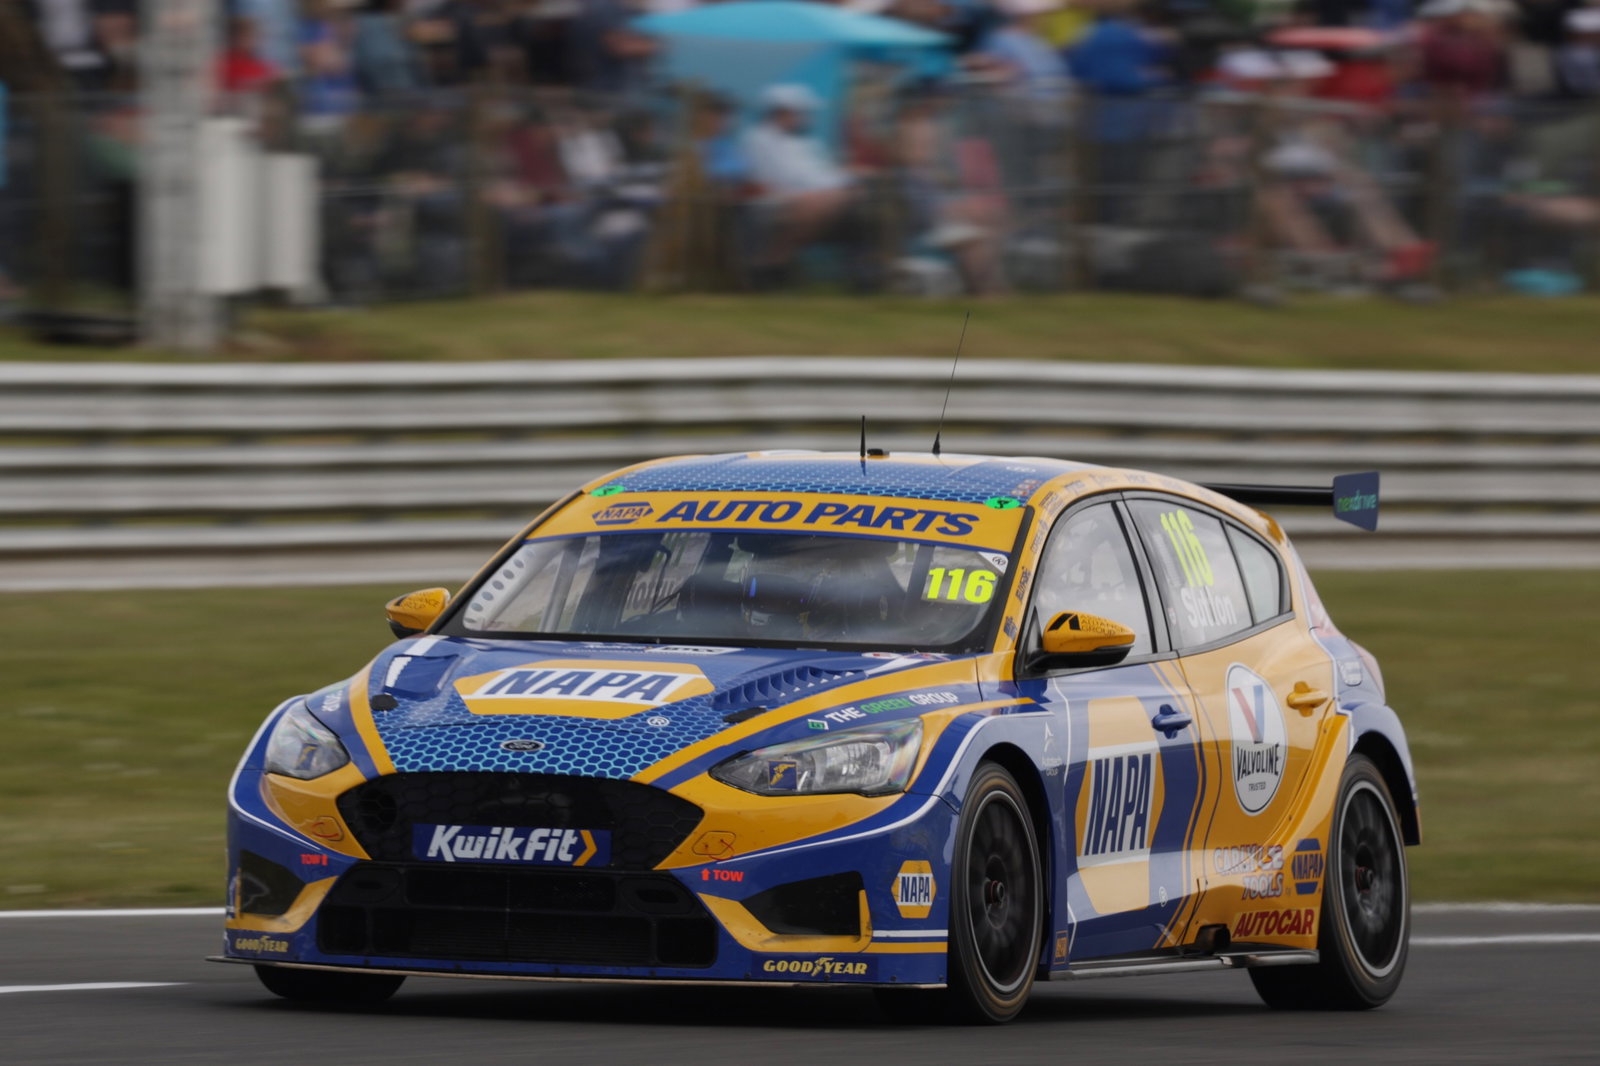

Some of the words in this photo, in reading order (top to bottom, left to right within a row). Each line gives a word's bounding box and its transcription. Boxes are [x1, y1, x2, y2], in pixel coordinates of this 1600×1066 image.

[599, 507, 643, 519] NAPA
[656, 500, 803, 522] AUTO
[803, 502, 980, 536] PARTS
[1160, 509, 1214, 587] 116
[927, 568, 997, 604] 116
[485, 669, 680, 702] NAPA
[825, 707, 866, 723] THE
[860, 697, 916, 714] GREEN
[908, 692, 959, 706] GROUP
[1236, 742, 1280, 782] VALVOLINE
[1248, 781, 1266, 791] TRUSTED
[1084, 753, 1152, 856] NAPA
[300, 854, 320, 865] TOW
[1294, 853, 1320, 880] NAPA
[713, 869, 744, 882] TOW
[898, 875, 931, 903] NAPA
[1242, 873, 1284, 900] TOOLS
[1232, 909, 1315, 938] AUTOCAR
[235, 936, 289, 953] GOODYEAR
[763, 957, 868, 976] GOODYEAR
